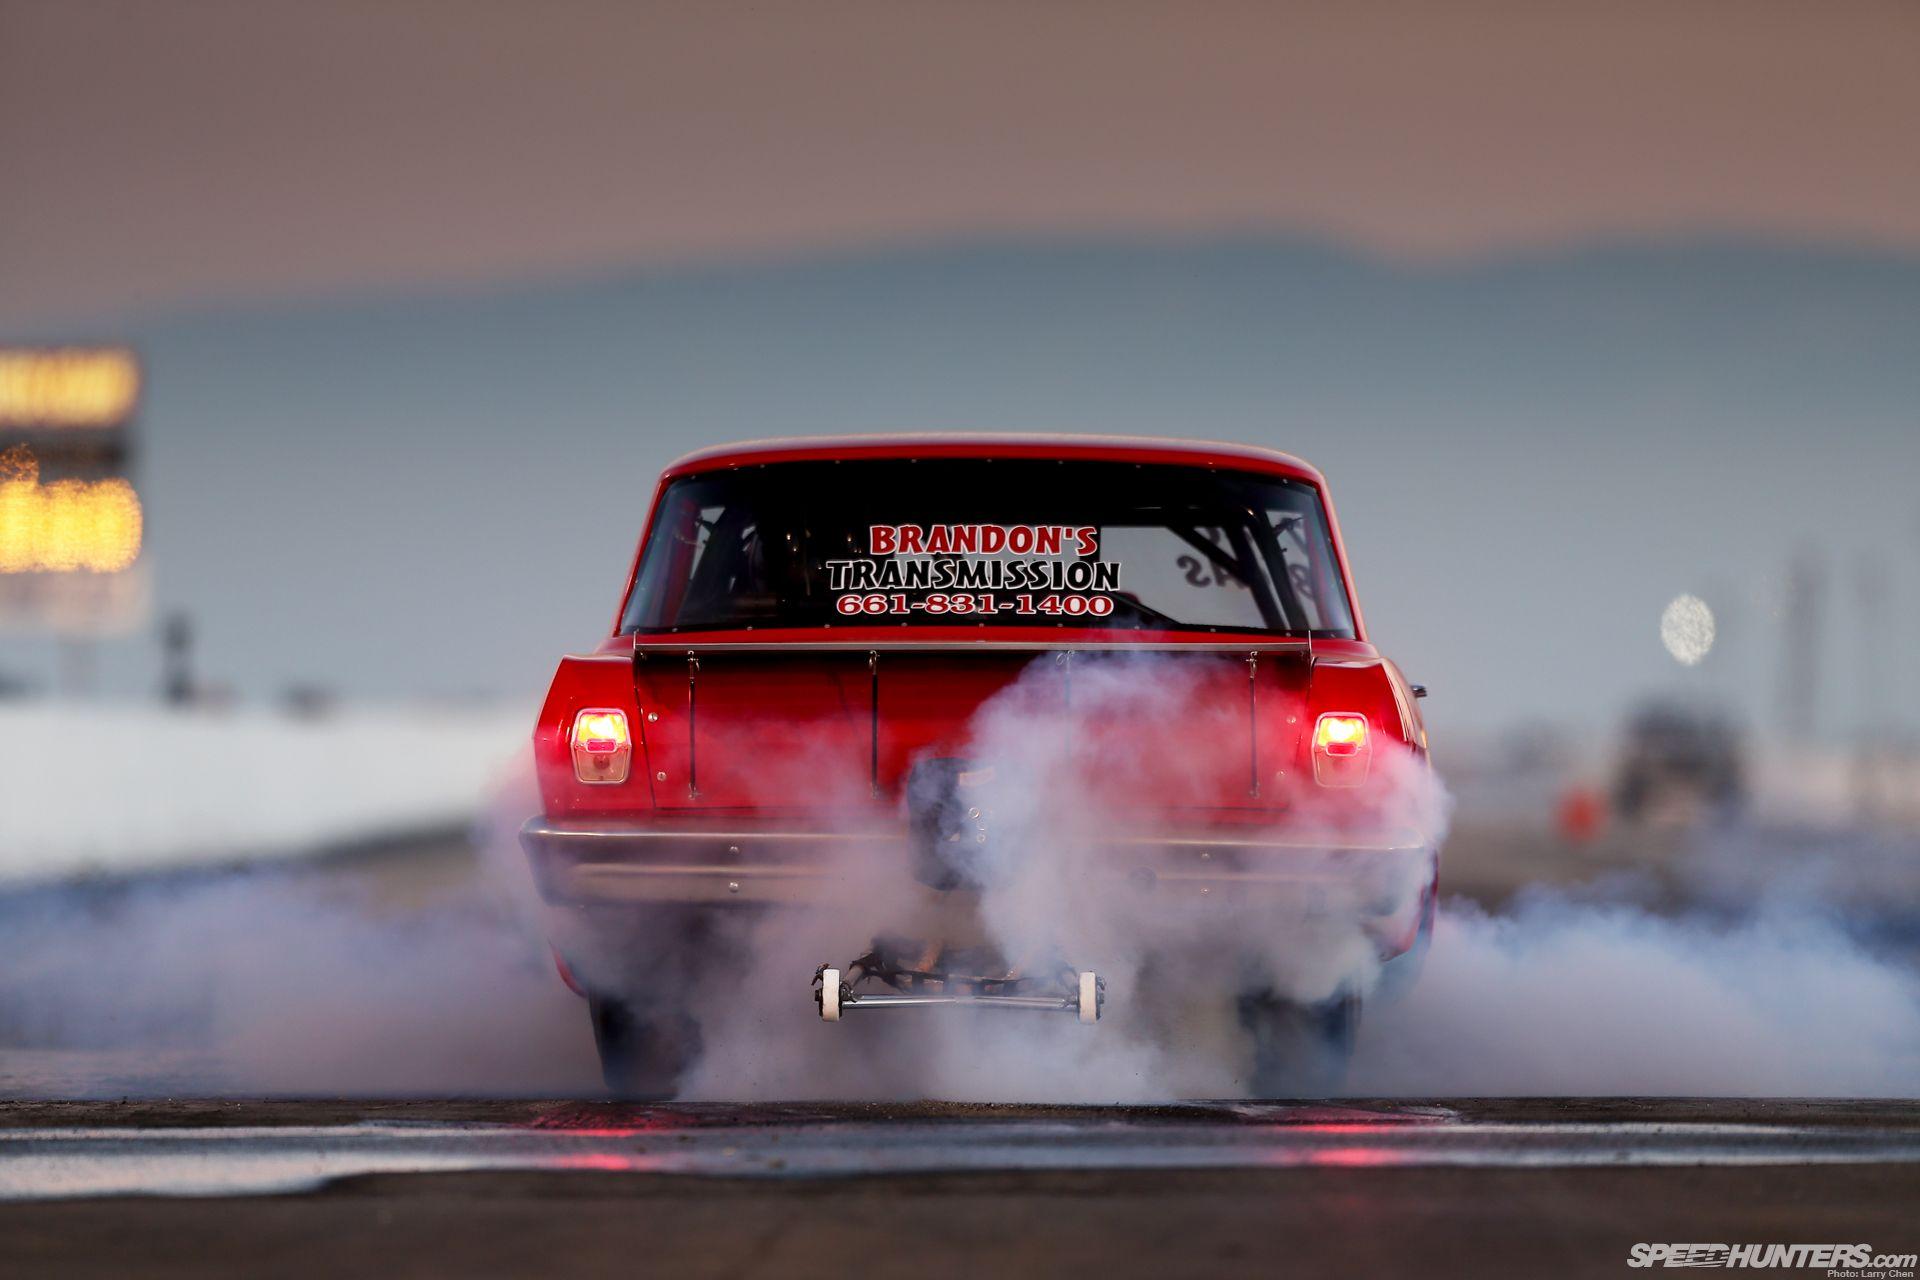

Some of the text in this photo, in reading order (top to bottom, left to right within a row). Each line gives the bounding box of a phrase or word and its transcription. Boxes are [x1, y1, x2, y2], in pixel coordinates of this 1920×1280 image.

[869, 524, 1097, 555] BRANDON'S
[826, 559, 1121, 591] TRANSMISSION
[836, 594, 1114, 616] 661-831-1400
